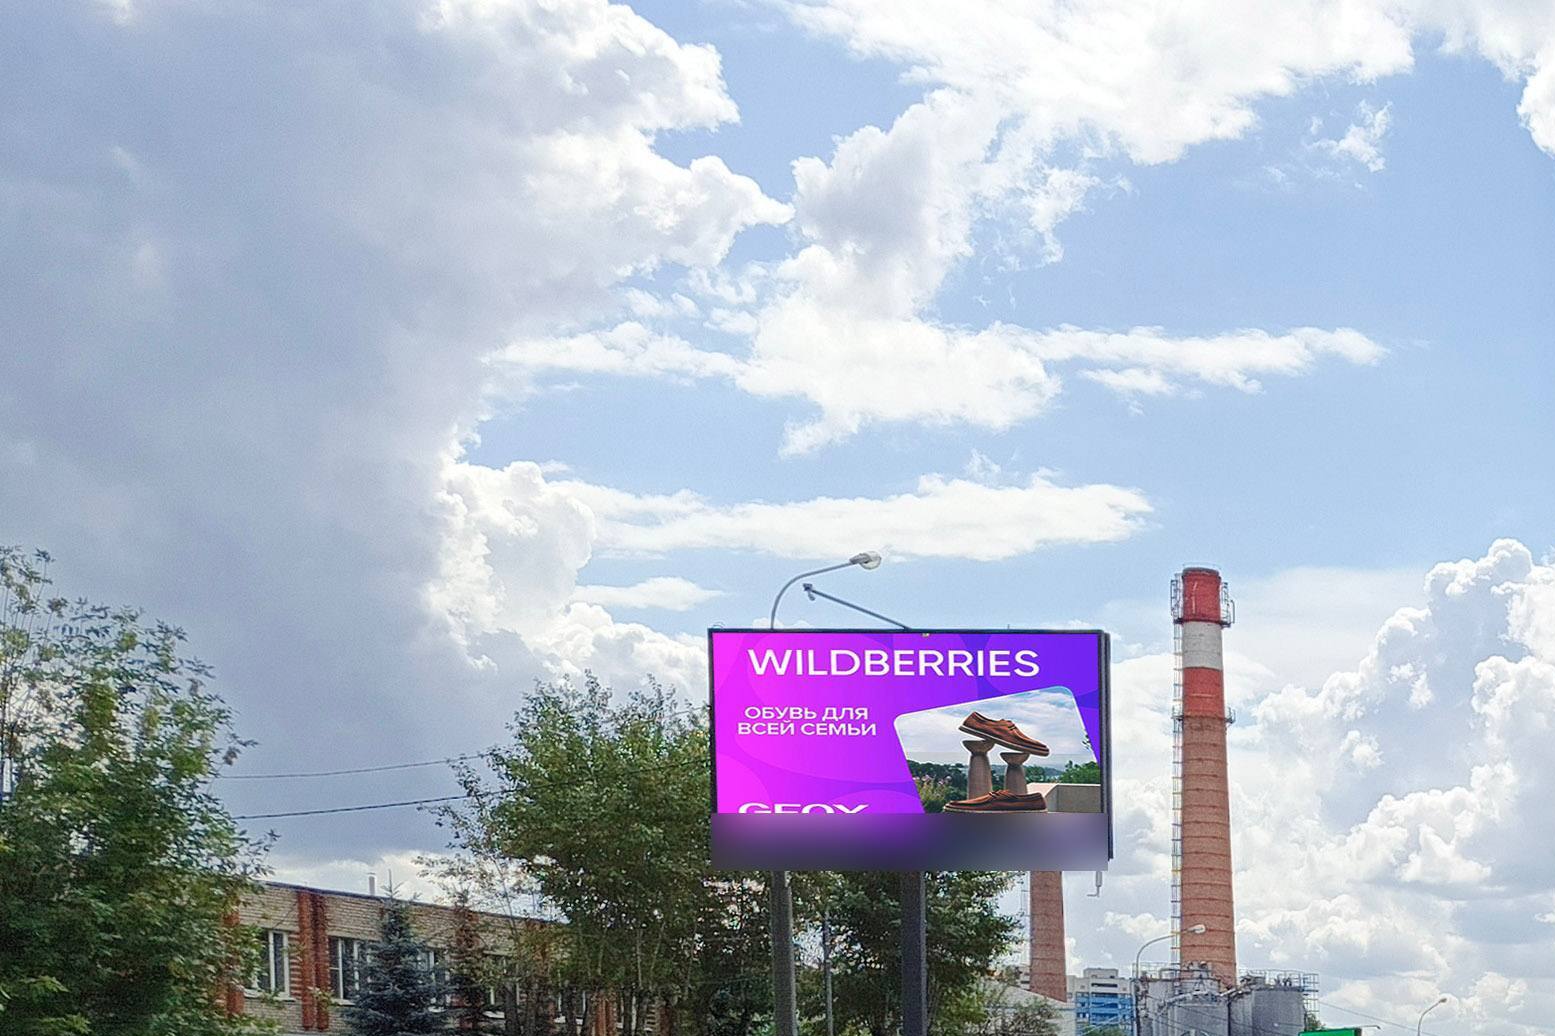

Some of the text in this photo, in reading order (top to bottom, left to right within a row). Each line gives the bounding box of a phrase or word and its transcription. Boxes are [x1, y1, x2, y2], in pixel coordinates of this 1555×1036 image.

[748, 649, 1040, 677] WILDBERRIES
[744, 706, 869, 722] ОБУВЬ ДЛЯ
[737, 719, 877, 736] ВСЕЙ СЕМЬИ
